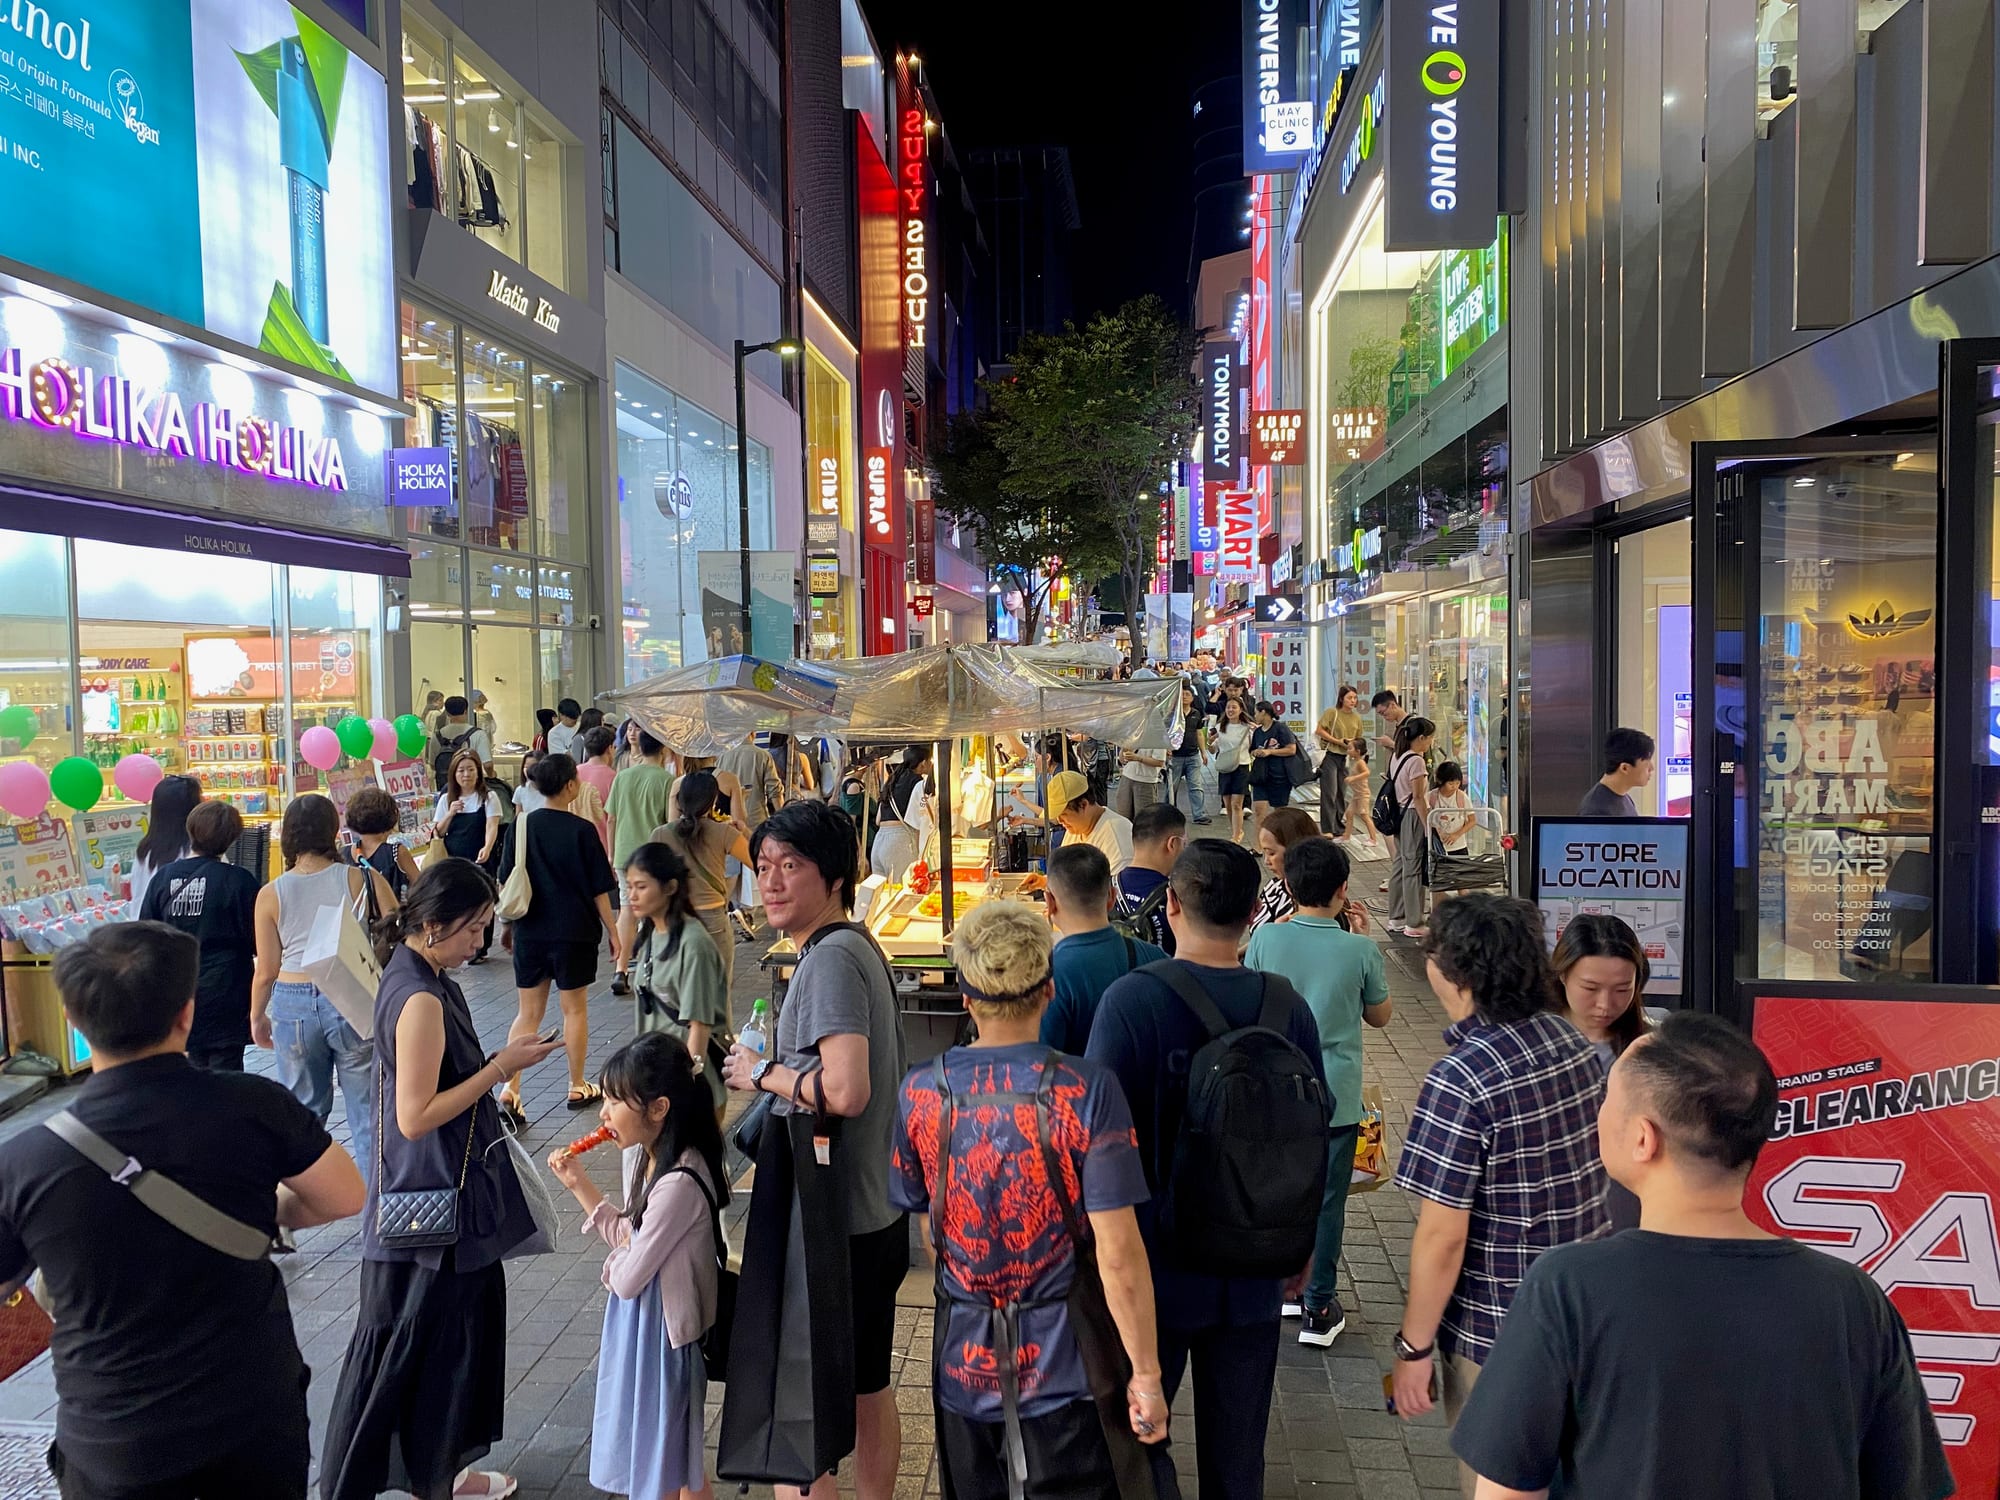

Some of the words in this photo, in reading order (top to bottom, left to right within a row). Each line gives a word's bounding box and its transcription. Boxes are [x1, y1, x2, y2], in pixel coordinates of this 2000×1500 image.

[0, 0, 92, 71] inol
[18, 56, 58, 91] Origin
[61, 79, 112, 120] Formula
[117, 98, 160, 146] Vegan
[1277, 107, 1301, 116] MAY
[1269, 118, 1309, 129] CLINIC
[1284, 134, 1295, 142] 3F
[13, 141, 45, 172] INC.
[1431, 99, 1457, 211] YOUNG
[1446, 254, 1470, 306] LIVE
[488, 269, 528, 315] Matin
[534, 296, 561, 334] Kim
[1213, 353, 1231, 468] TONYMOLY
[1256, 415, 1302, 429] JUNO
[1260, 428, 1297, 442] HAIR
[198, 402, 349, 491] HOLIKA
[1270, 450, 1286, 462] 4F
[398, 464, 446, 478] HOLIKA
[399, 476, 447, 490] HOLIKA
[868, 455, 886, 524] SUPRA
[1224, 493, 1253, 570] MART
[184, 534, 219, 551] HOLIKA
[220, 538, 255, 556] HOLIKA
[1792, 558, 1835, 577] ABC
[1791, 578, 1835, 592] MART
[124, 658, 151, 669] CARE
[1271, 641, 1286, 716] JUNO
[1289, 642, 1303, 715] HAIR
[1720, 761, 1735, 769] ABC
[1565, 842, 1658, 863] STORE
[1541, 868, 1681, 889] LOCATION
[1826, 1060, 1875, 1080] STAGE
[1767, 1057, 2000, 1142] CLEARANC
